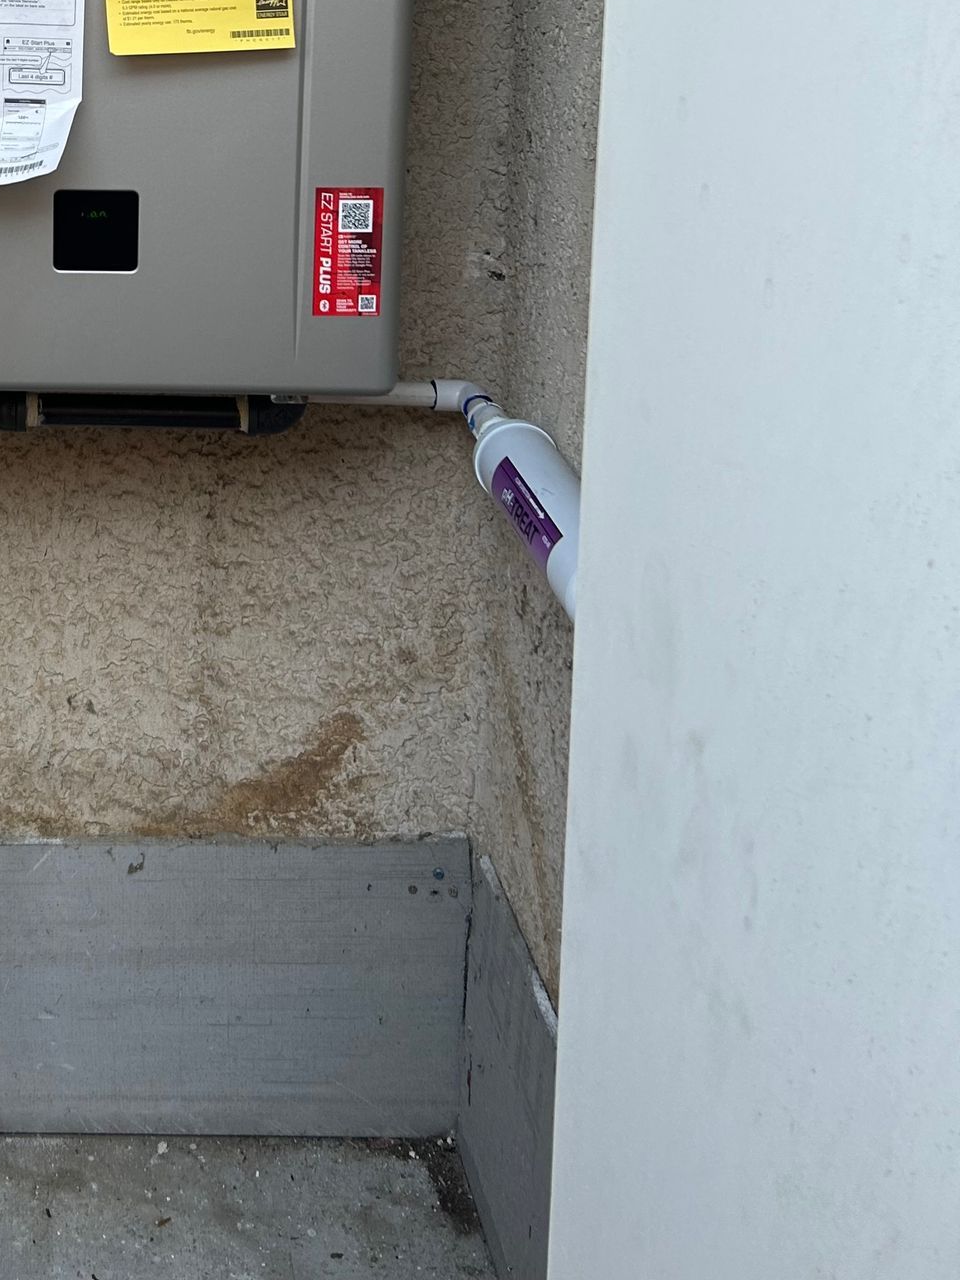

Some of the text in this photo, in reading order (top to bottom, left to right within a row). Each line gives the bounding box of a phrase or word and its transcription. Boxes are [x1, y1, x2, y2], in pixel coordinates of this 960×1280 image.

[319, 192, 333, 294] EZ START PLUS
